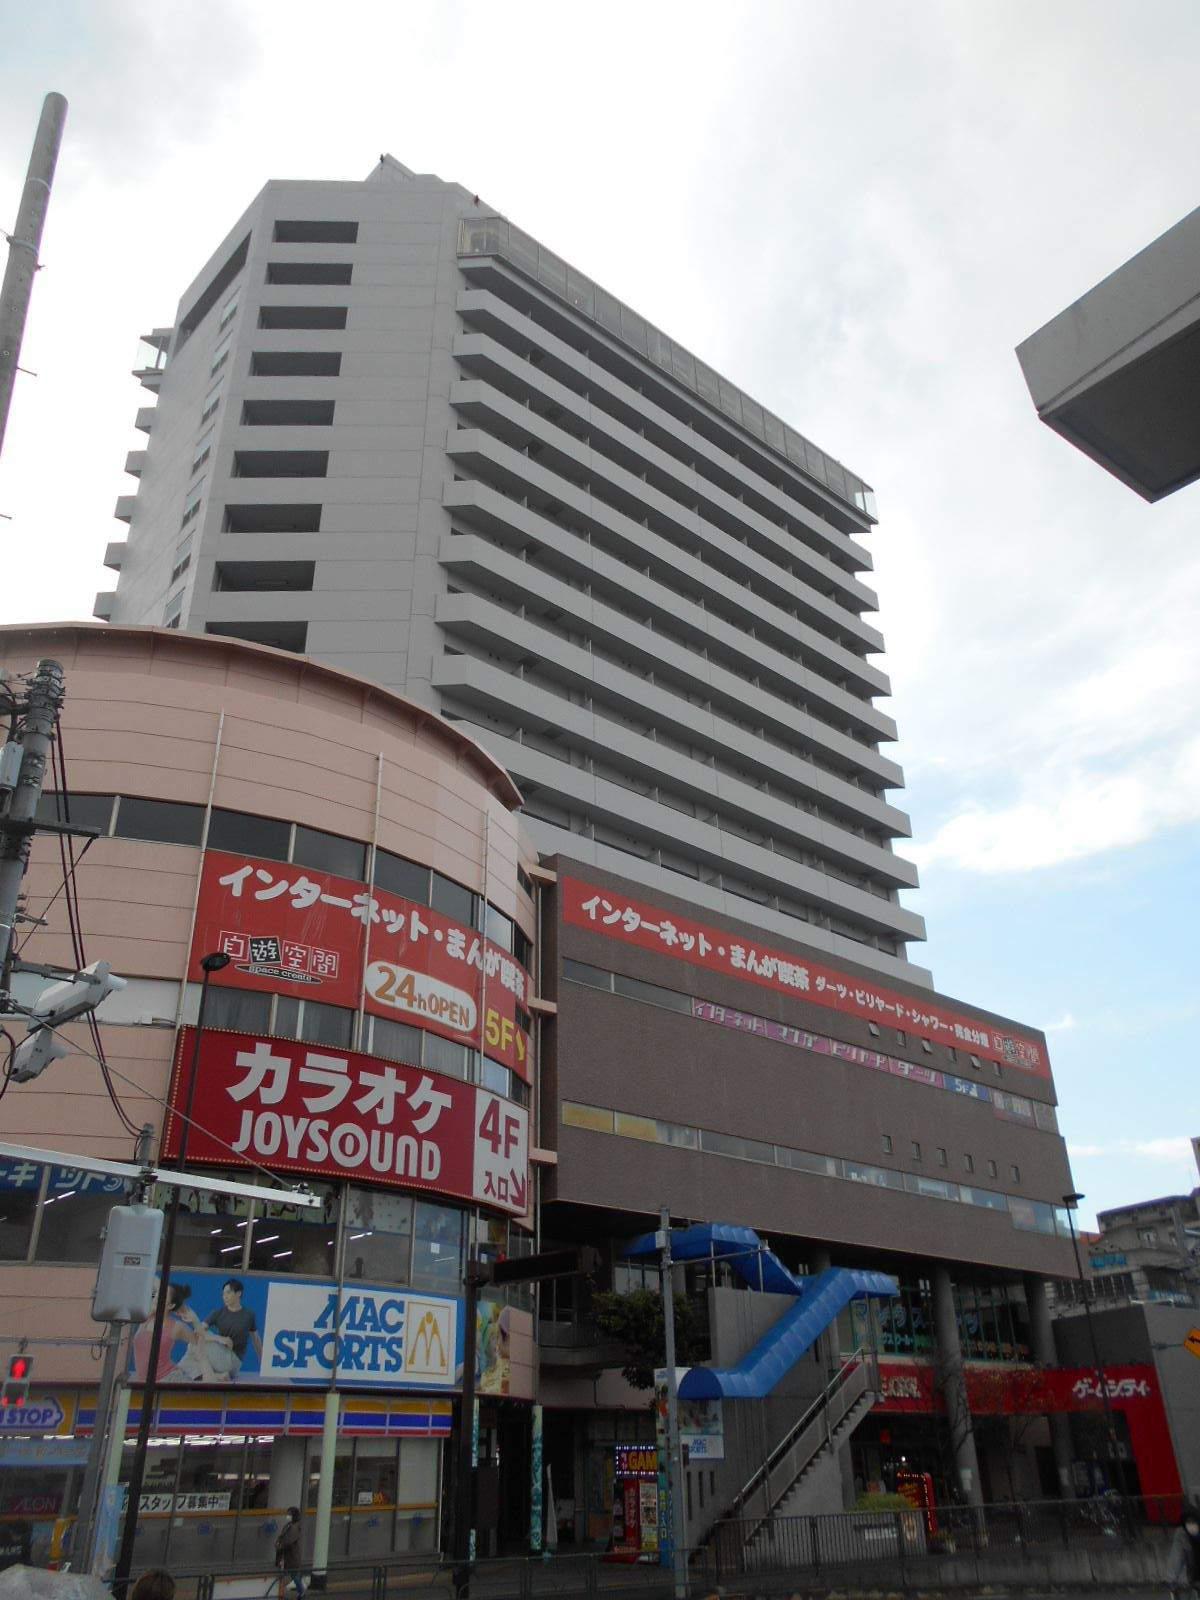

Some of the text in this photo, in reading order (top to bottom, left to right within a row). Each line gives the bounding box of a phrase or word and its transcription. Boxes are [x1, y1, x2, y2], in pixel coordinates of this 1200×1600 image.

[485, 1007, 515, 1051] 5F
[226, 1042, 453, 1134] カラオケ
[232, 1109, 441, 1181] JOYSOUND
[479, 1098, 521, 1160] 4F
[483, 1171, 509, 1200] 入口
[314, 1294, 405, 1334] MAC
[272, 1329, 403, 1373] SPORTS
[7, 1408, 53, 1425] STOP
